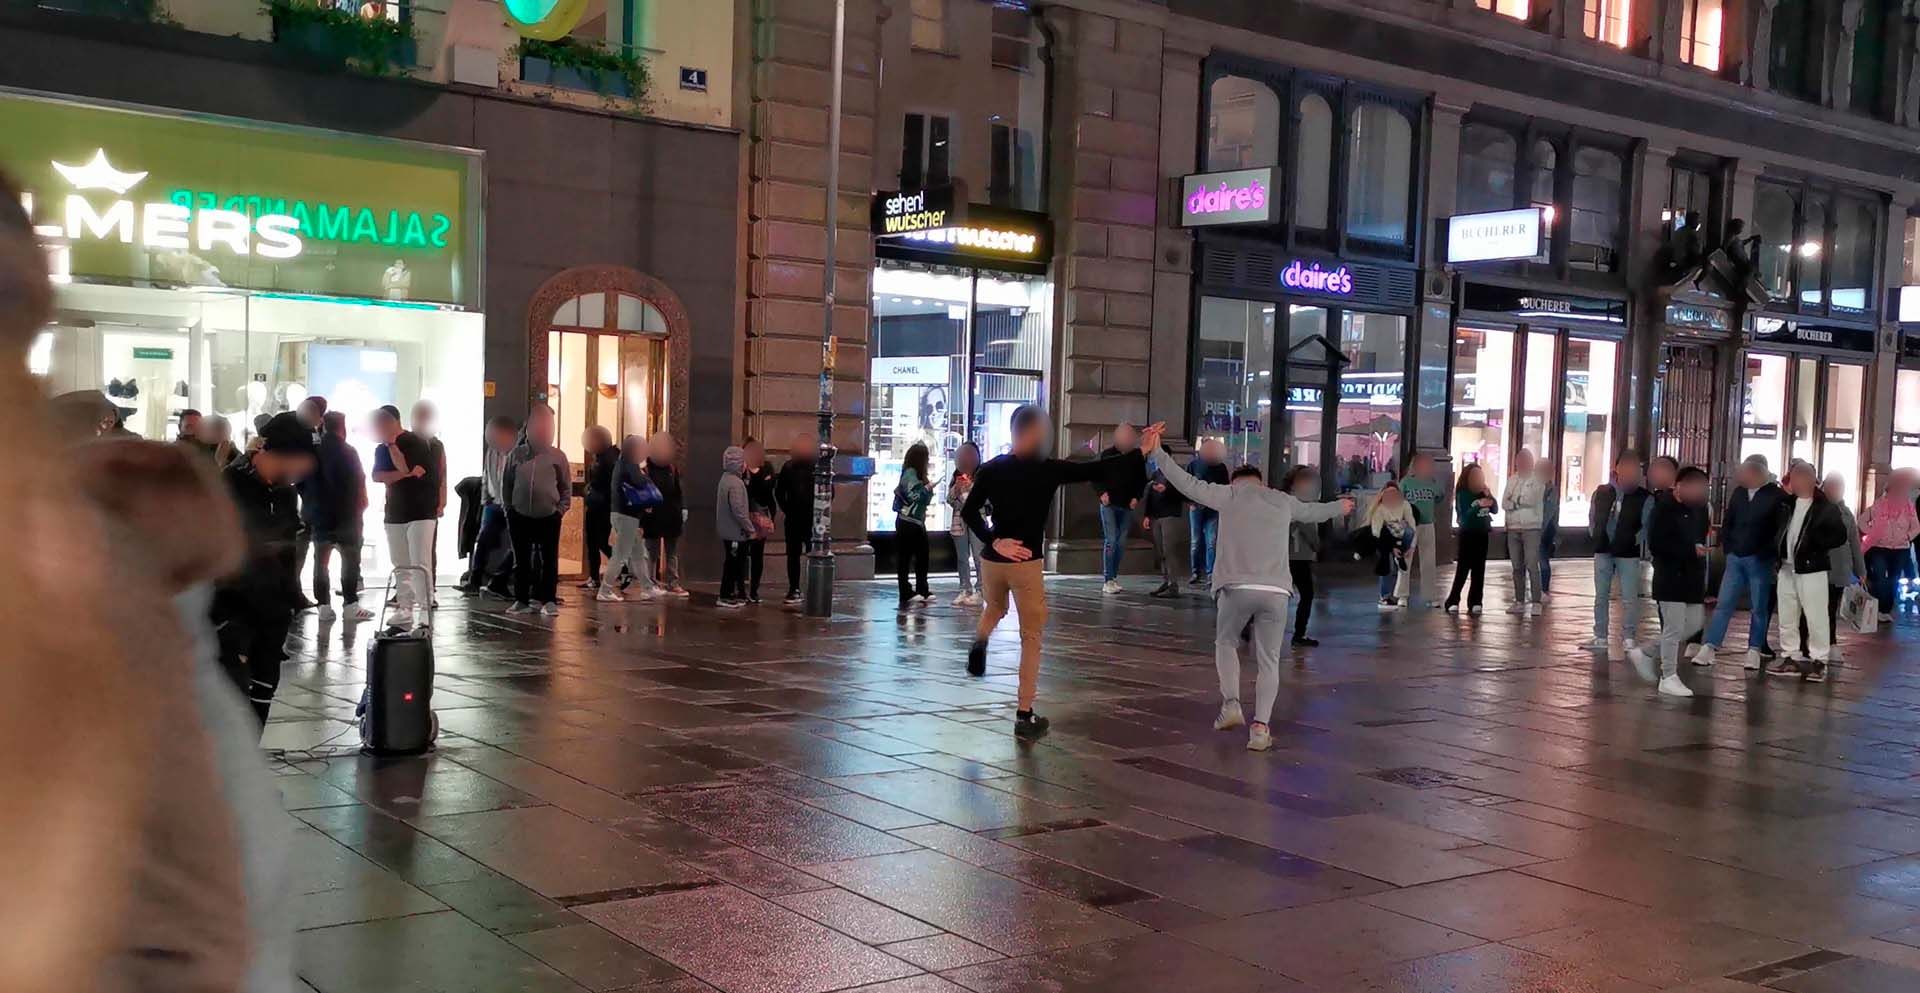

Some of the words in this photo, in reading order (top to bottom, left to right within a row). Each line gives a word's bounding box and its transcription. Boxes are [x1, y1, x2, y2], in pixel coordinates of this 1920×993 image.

[689, 71, 698, 84] 4
[885, 190, 924, 215] sehen!
[1187, 180, 1265, 214] claire's
[885, 210, 946, 233] wutscher
[1461, 223, 1527, 240] BUCHERER
[957, 226, 1036, 254] wutscher
[1280, 260, 1352, 294] claire's
[1522, 297, 1571, 313] BUCHERER
[1796, 327, 1833, 343] BUCHERER
[892, 365, 920, 375] CHANEL
